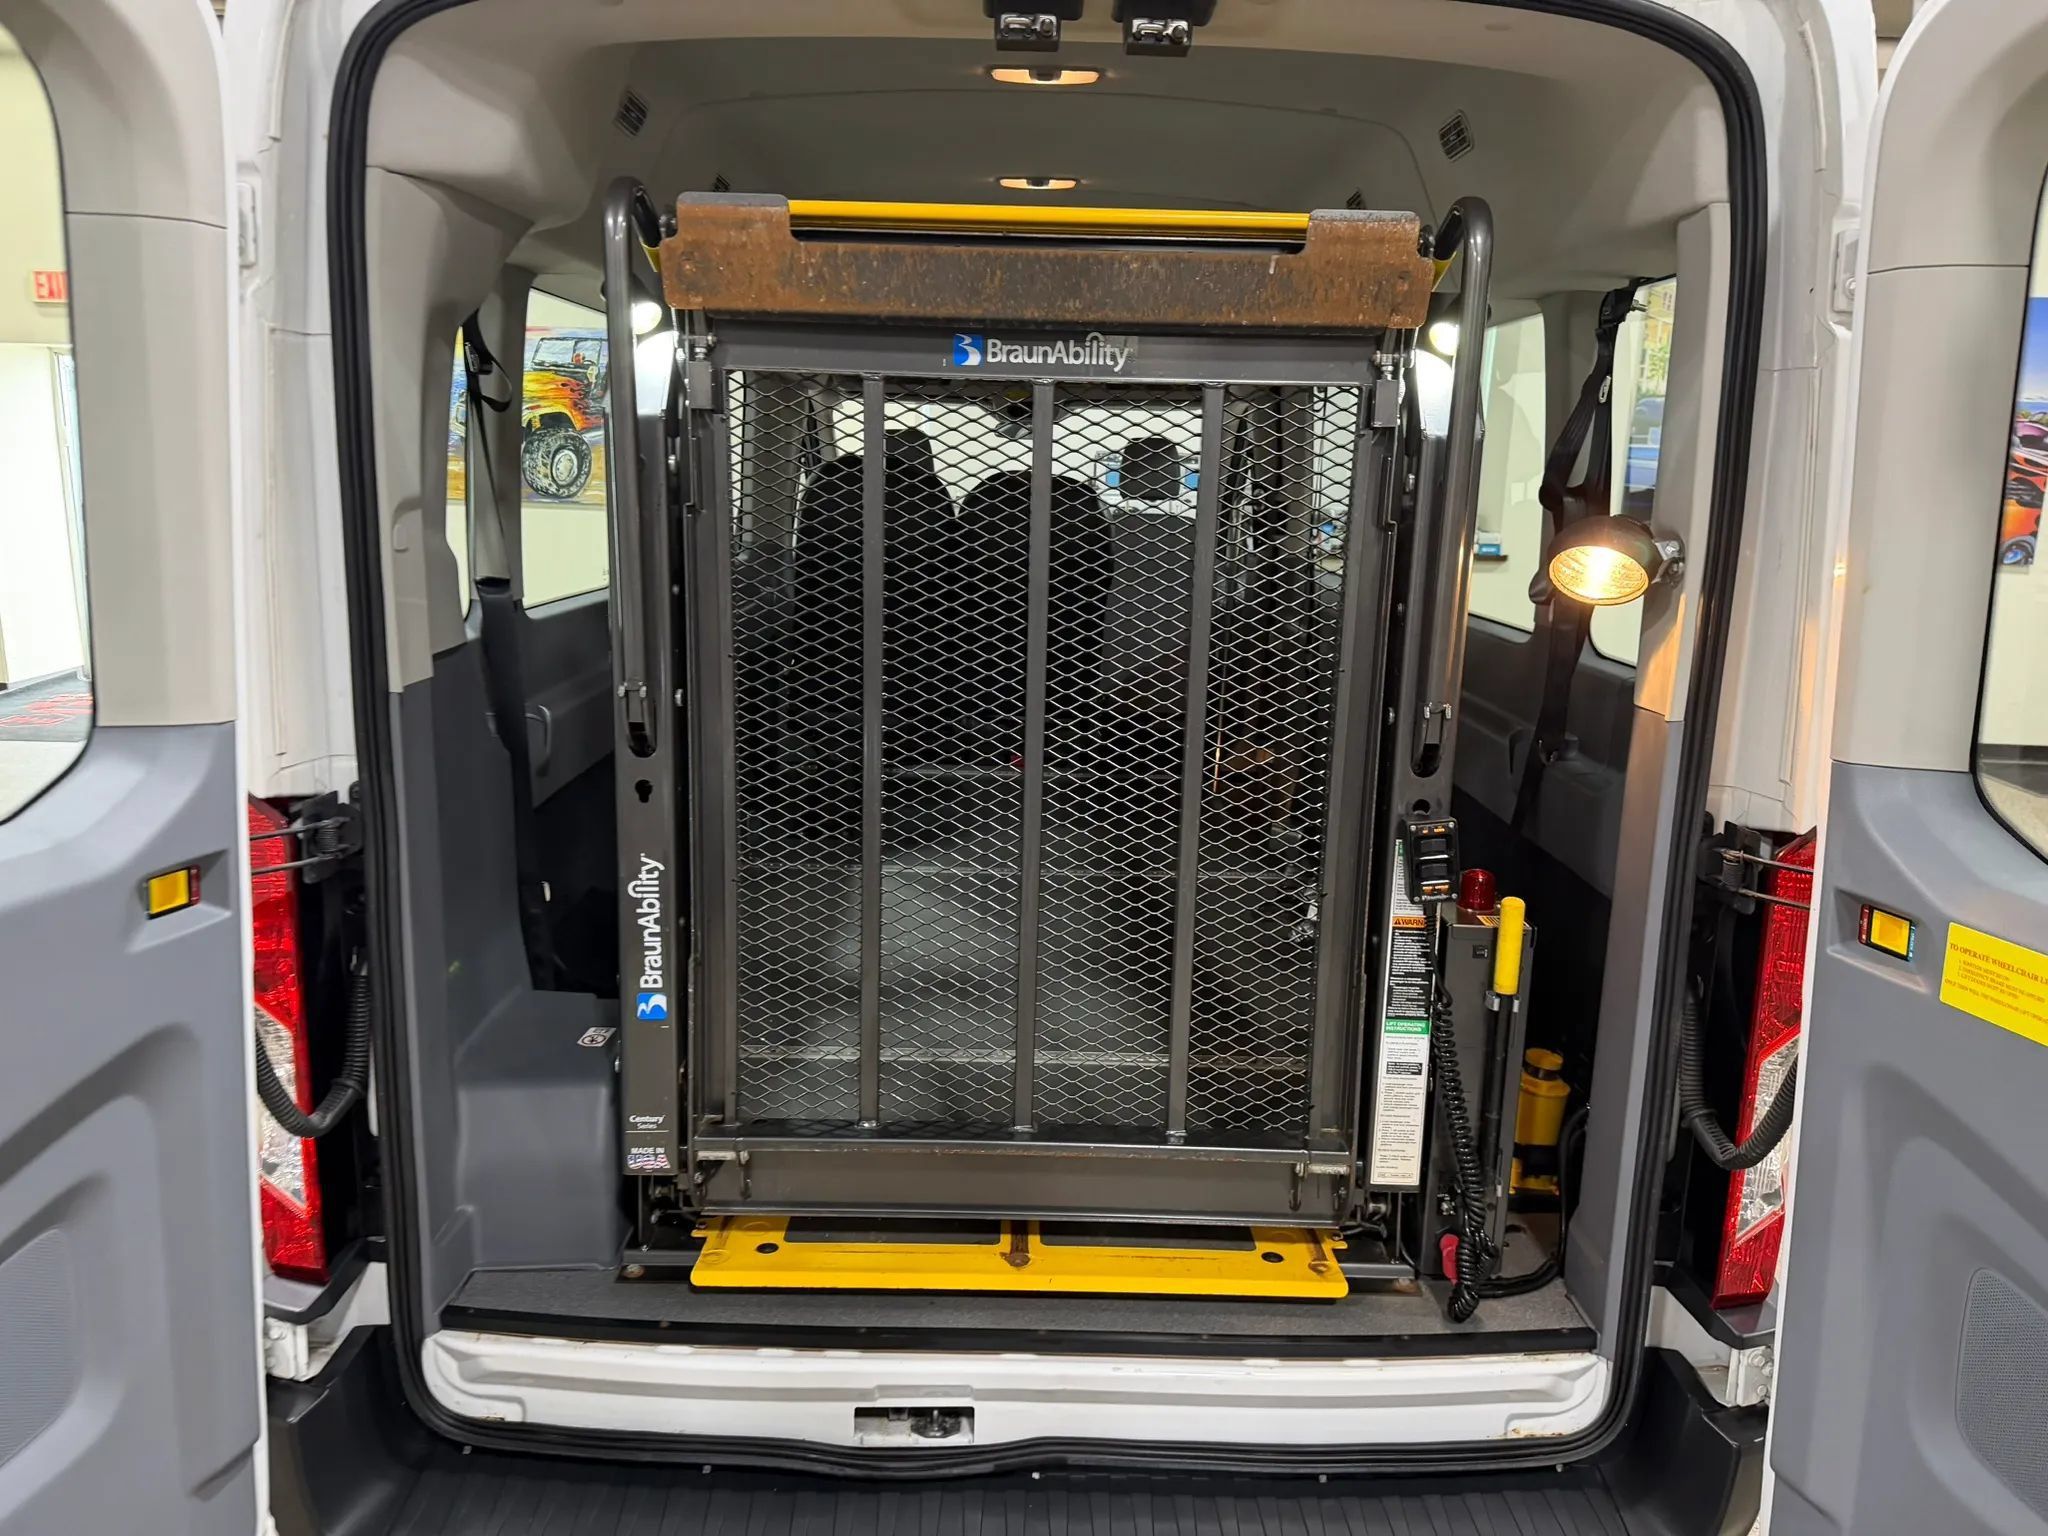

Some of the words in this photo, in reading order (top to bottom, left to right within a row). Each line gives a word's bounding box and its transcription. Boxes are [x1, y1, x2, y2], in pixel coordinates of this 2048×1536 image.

[986, 332, 1130, 372] BraunAbility
[628, 854, 666, 989] BraunAbility
[1959, 947, 1990, 962] OPERATE
[1990, 958, 2040, 982] WHEELCHAIR
[629, 1115, 666, 1124] Century
[627, 1154, 671, 1169] USA
